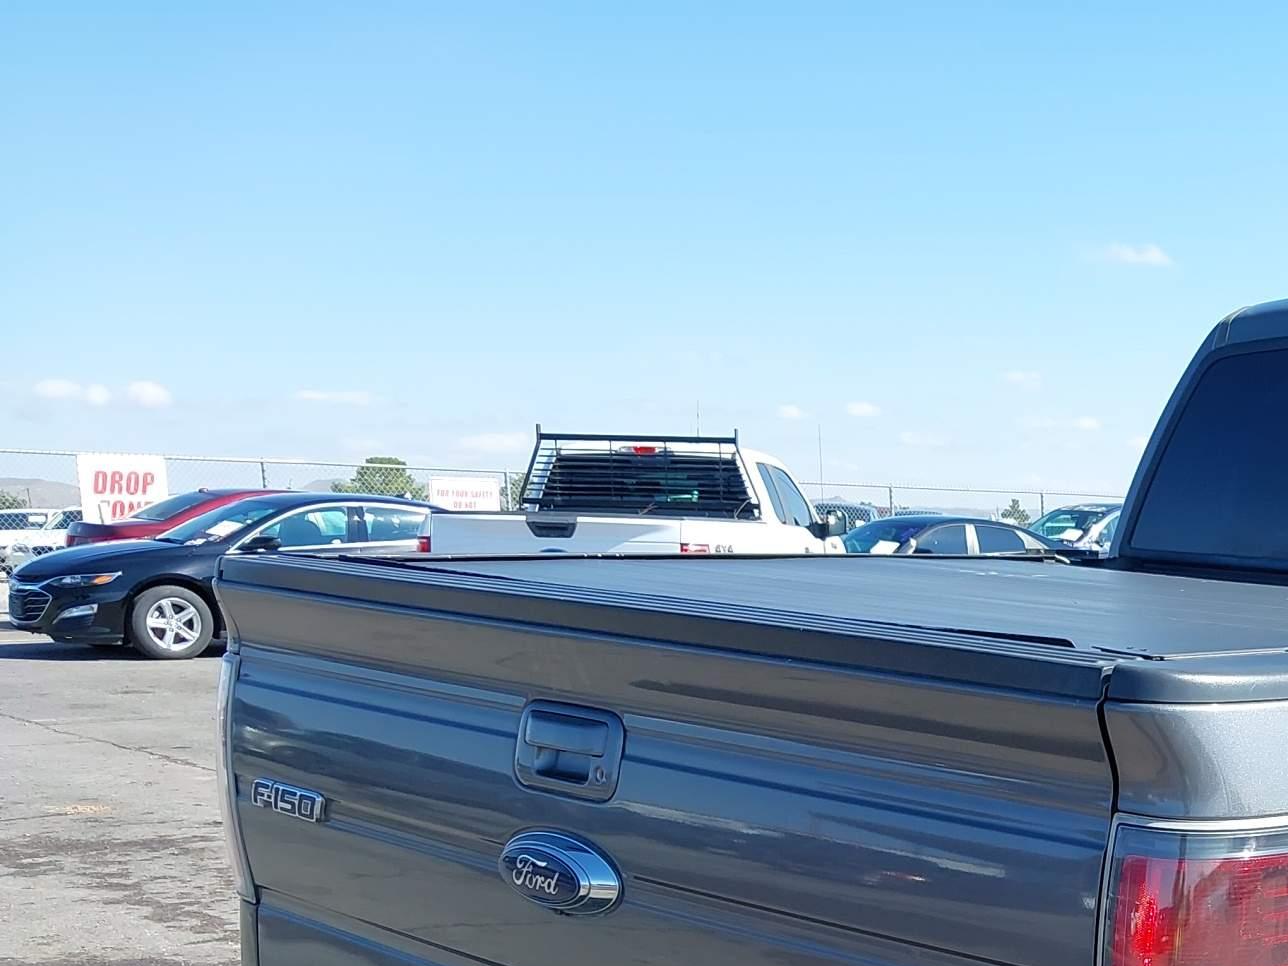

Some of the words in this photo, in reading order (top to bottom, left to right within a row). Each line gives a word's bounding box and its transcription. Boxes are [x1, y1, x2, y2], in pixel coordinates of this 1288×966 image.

[94, 471, 155, 495] DROP
[252, 778, 323, 823] F-150
[512, 854, 560, 895] Ford
